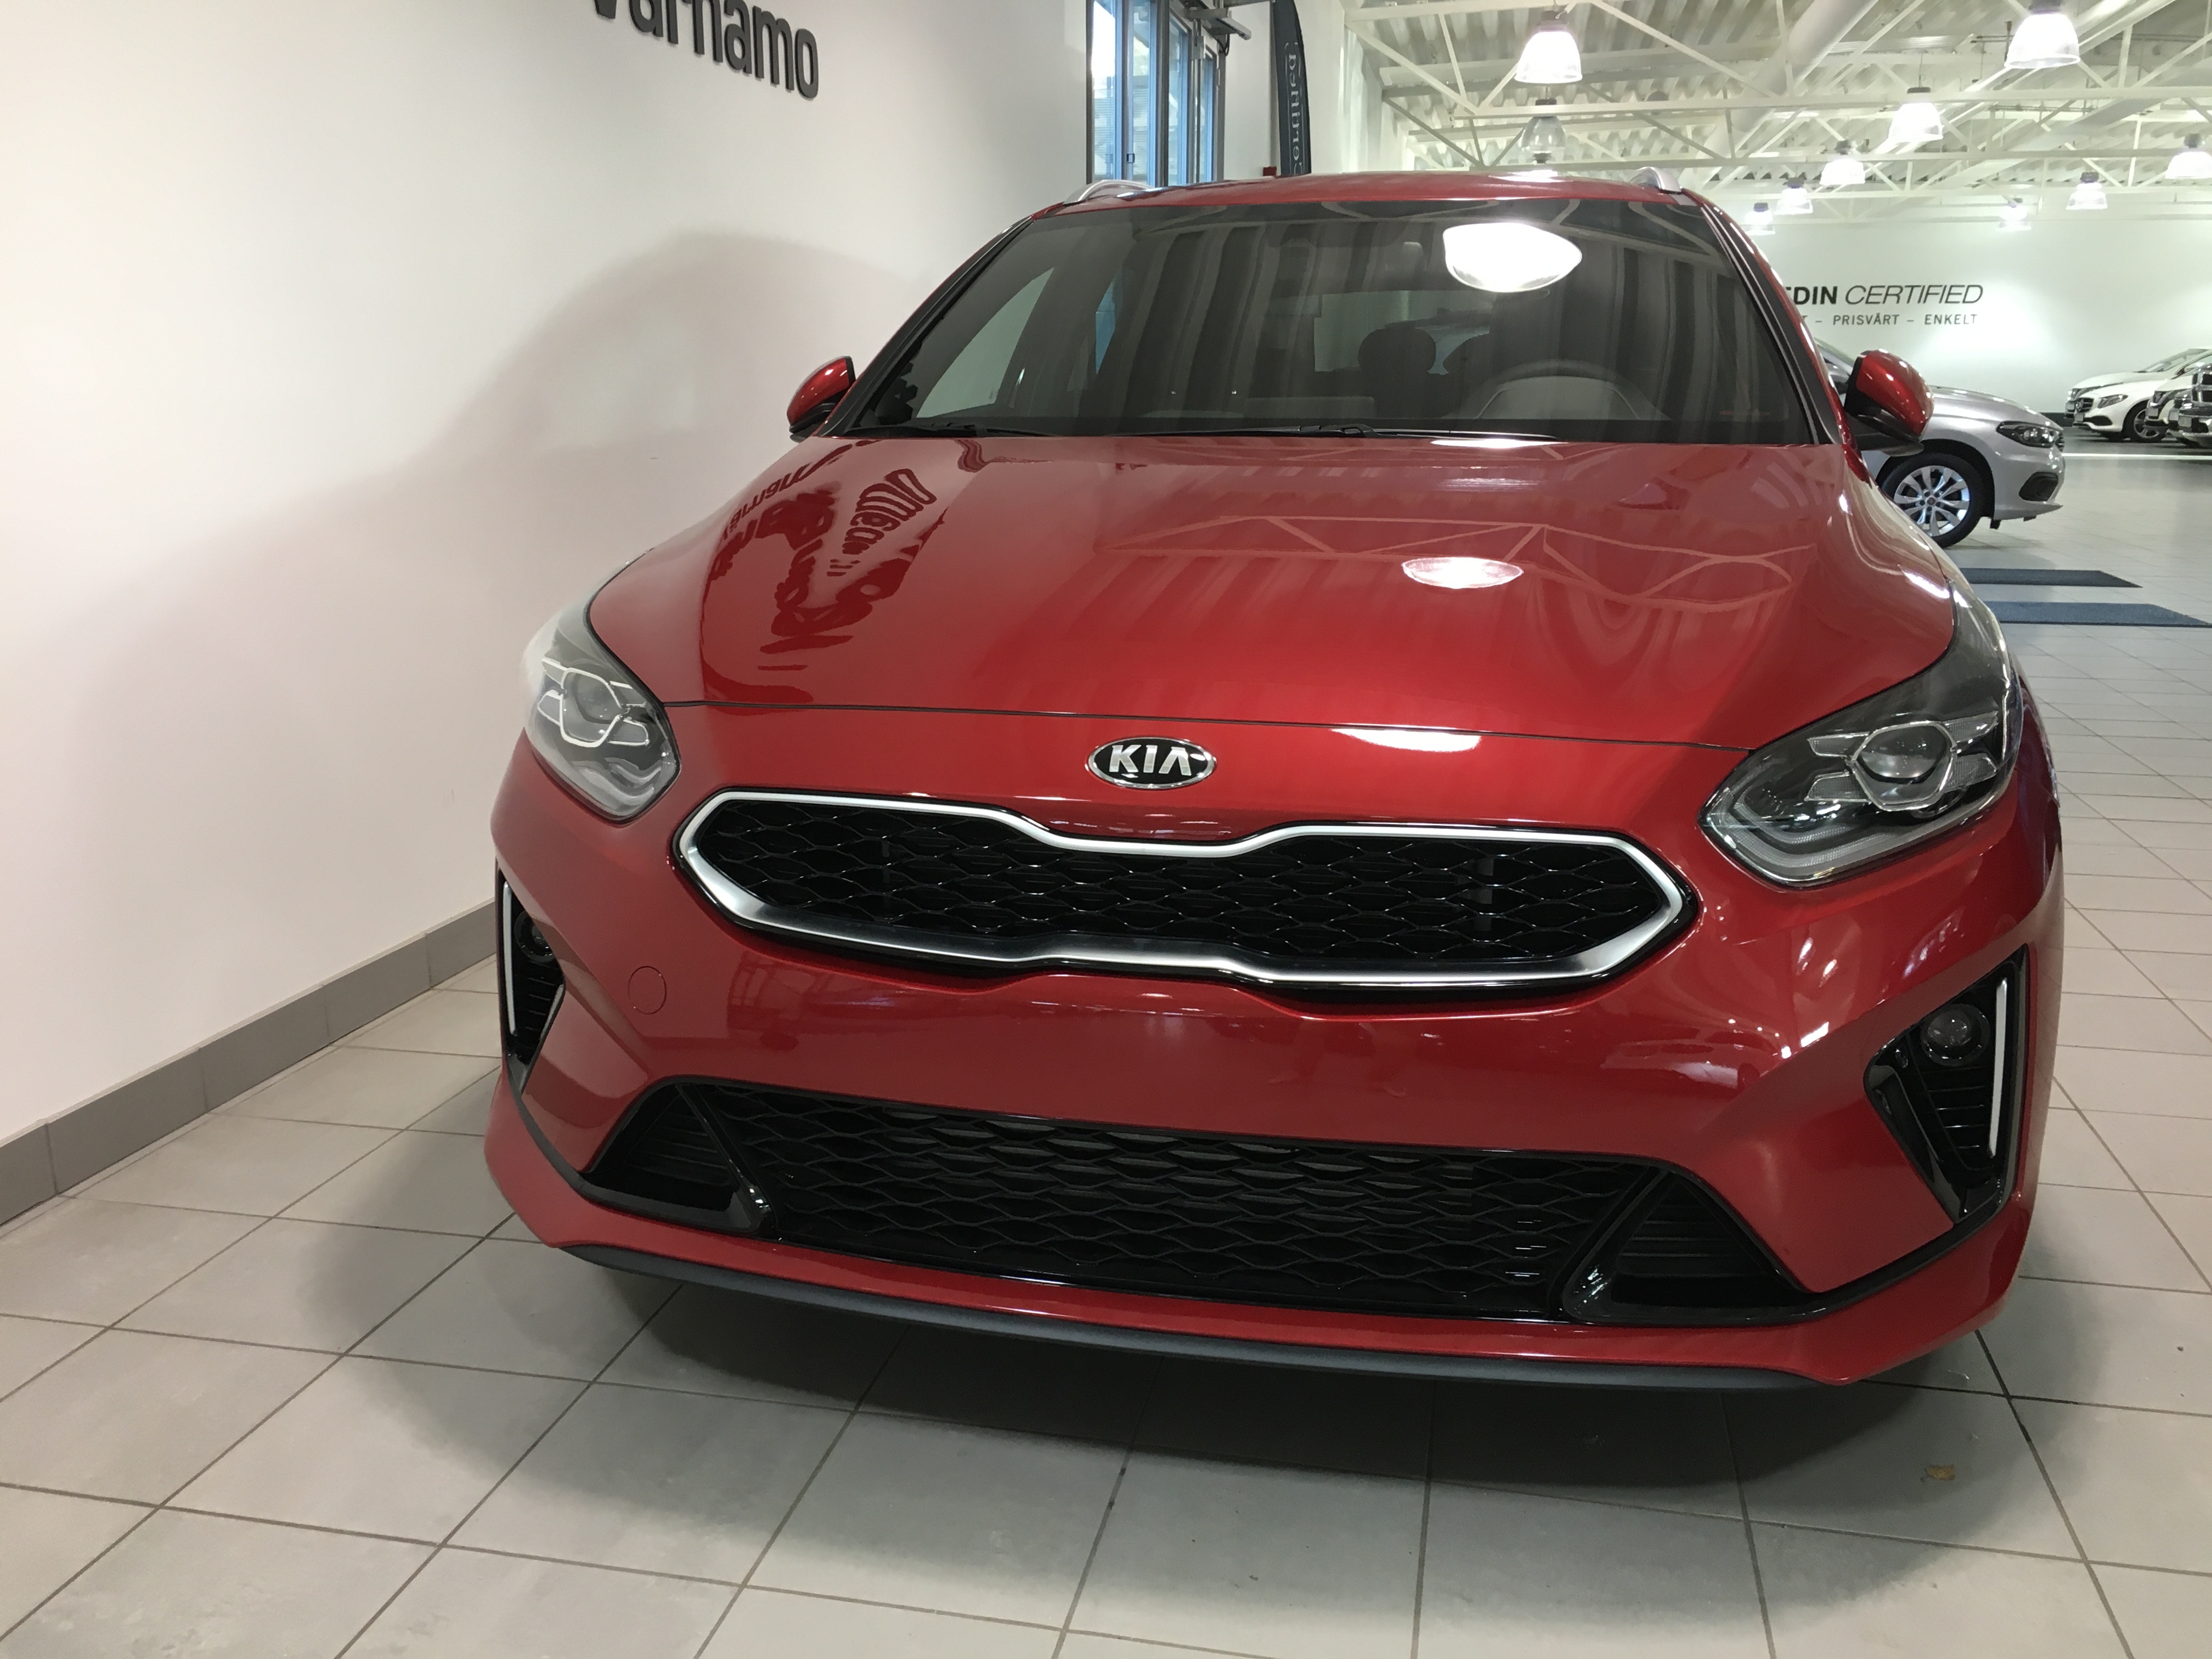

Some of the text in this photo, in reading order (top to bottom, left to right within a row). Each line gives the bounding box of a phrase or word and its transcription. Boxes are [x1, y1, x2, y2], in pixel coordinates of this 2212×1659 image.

[1785, 284, 1983, 305] DIN CERTIFIED
[1925, 314, 1977, 325] ENKELT
[1108, 744, 1192, 776] KIA
